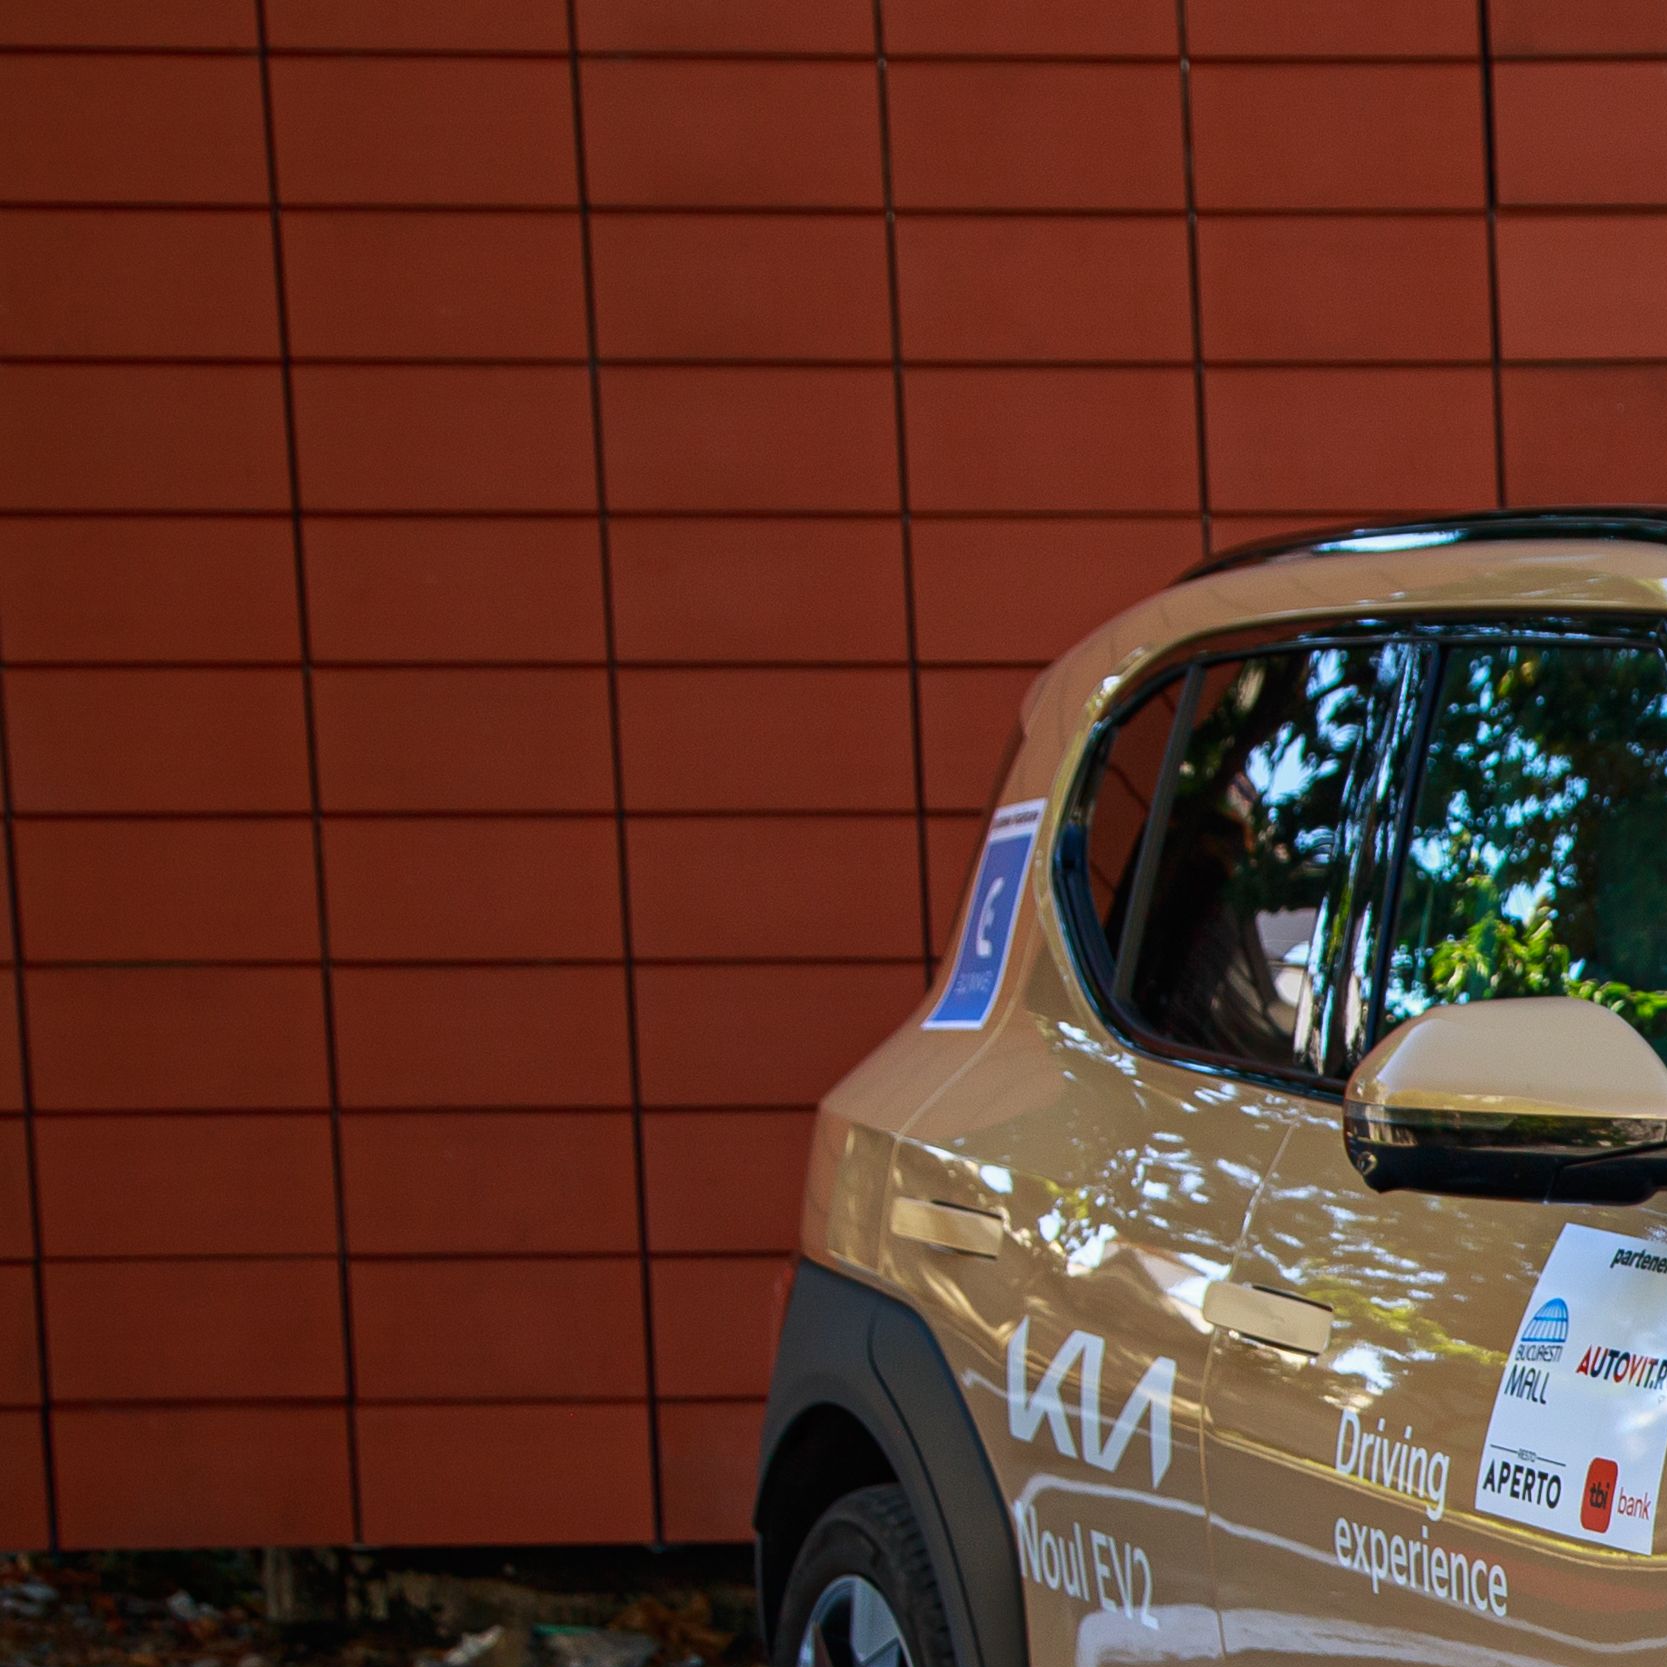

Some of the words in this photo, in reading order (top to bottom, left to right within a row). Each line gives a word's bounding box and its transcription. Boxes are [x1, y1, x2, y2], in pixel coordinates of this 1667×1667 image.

[1007, 1317, 1174, 1488] KIA
[1504, 1364, 1549, 1404] MALL
[1336, 1408, 1449, 1521] Driving
[1482, 1459, 1561, 1509] APERTO
[1617, 1487, 1652, 1520] bank
[1015, 1498, 1089, 1602] Noul
[1092, 1530, 1160, 1630] EV2
[1334, 1517, 1507, 1616] experience
